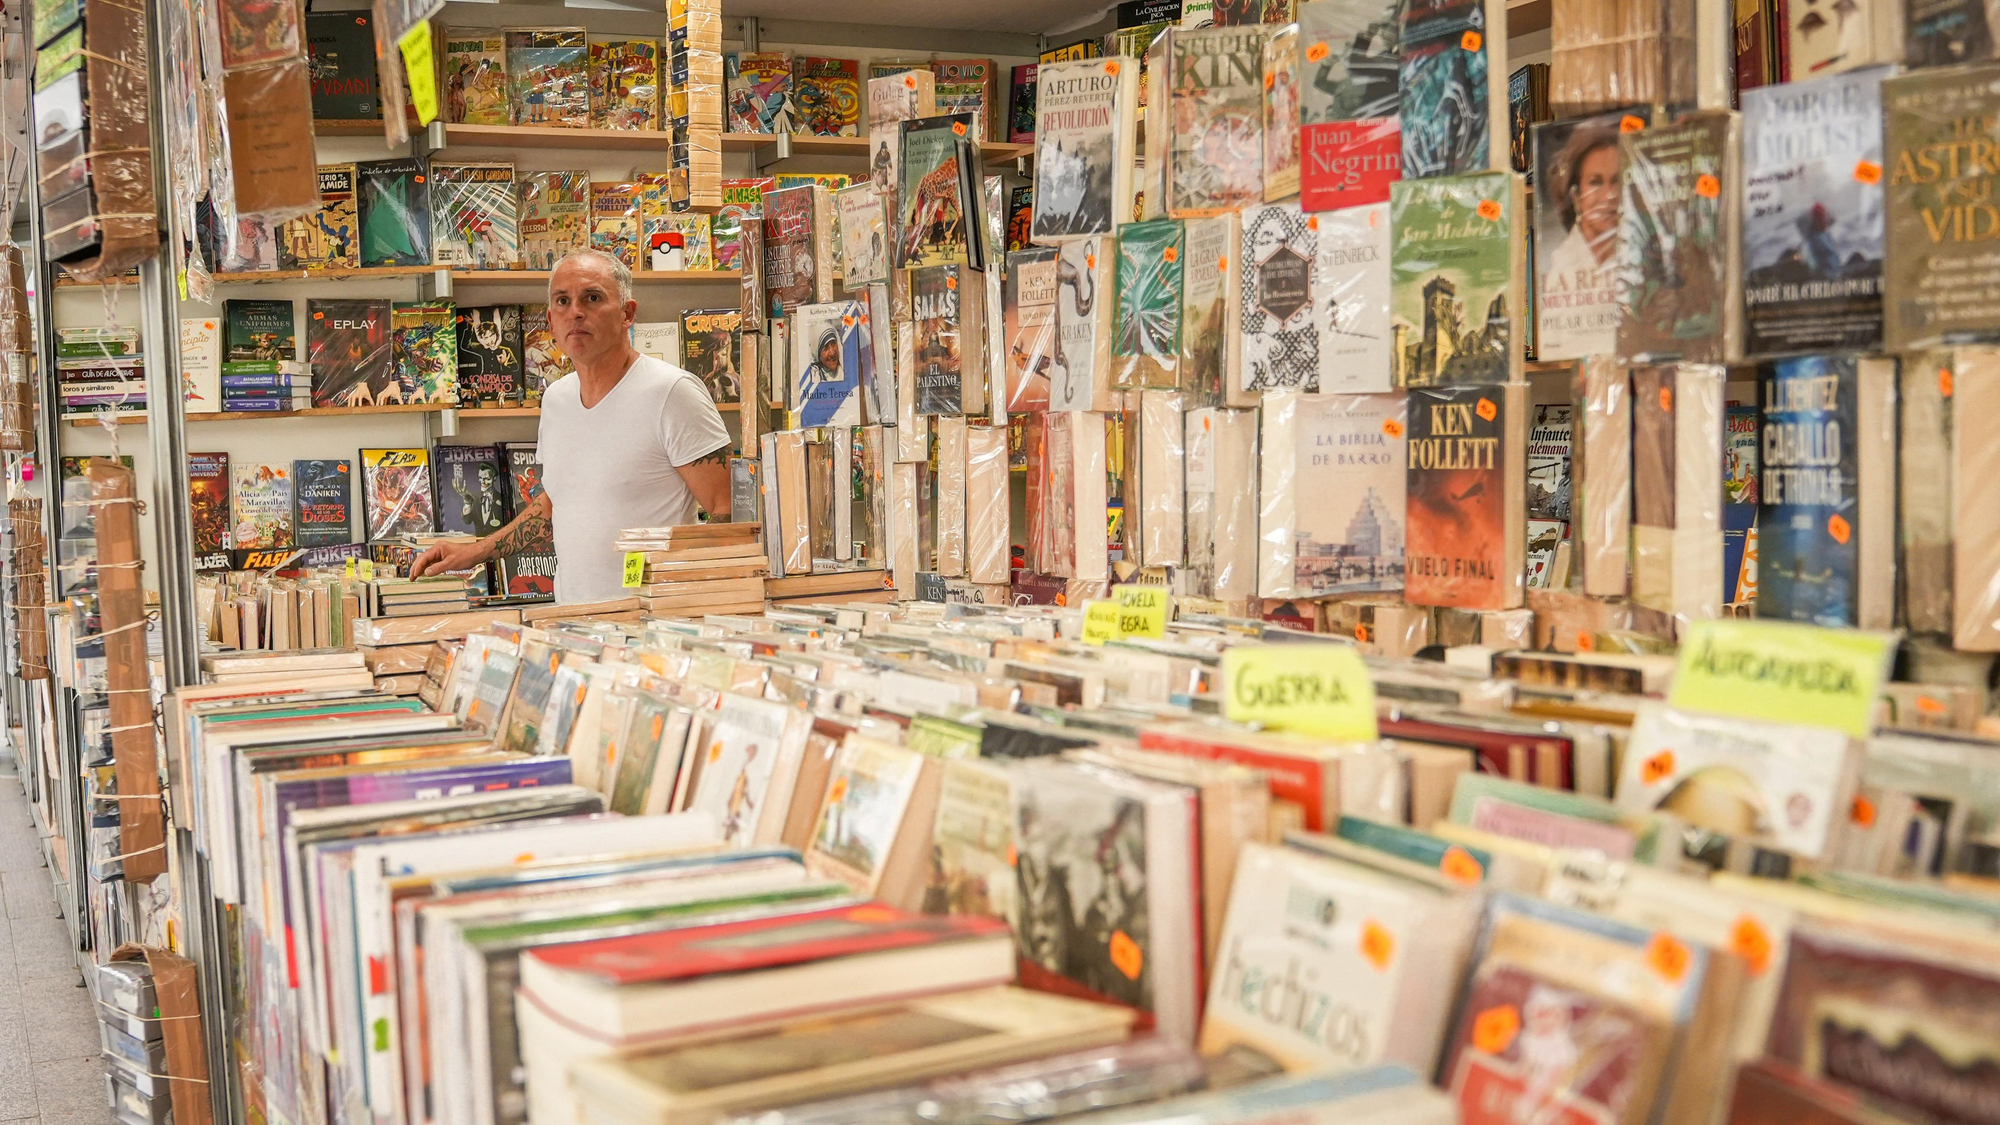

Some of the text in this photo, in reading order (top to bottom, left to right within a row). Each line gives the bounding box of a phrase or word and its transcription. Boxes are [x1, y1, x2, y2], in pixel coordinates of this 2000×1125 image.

[1173, 35, 1262, 57] STEPH
[826, 60, 843, 71] 4
[808, 69, 853, 79] FANTASTICOS
[873, 86, 904, 102] Gulag
[1045, 76, 1112, 96] ARTURO
[1044, 92, 1112, 107] PÉREZ-REVERTE
[1043, 105, 1110, 132] REVOLUCIÓN
[1310, 127, 1351, 150] Juan
[1309, 145, 1400, 185] Negrín
[1890, 137, 2000, 187] ASTR
[463, 171, 484, 181] FLASH
[485, 170, 511, 181] GORDON
[595, 197, 628, 205] JOHAN
[723, 186, 763, 204] LA MASA
[763, 189, 812, 212] STEPHEN
[764, 206, 813, 242] KING
[1321, 244, 1380, 267] STEINBECK
[1029, 277, 1046, 288] KEN
[1021, 287, 1055, 302] FOLLETT
[914, 289, 956, 321] SALAS
[240, 320, 291, 328] UNIFORMES
[324, 319, 377, 330] REPLAY
[685, 314, 742, 334] CREEP
[1061, 322, 1093, 342] KRAKEN
[82, 369, 96, 378] GUÍA
[929, 364, 940, 375] EL
[460, 374, 514, 385] LA SONRISA DEL
[916, 374, 957, 388] PALESTINO
[802, 386, 854, 401] Madre Teresa
[1430, 402, 1474, 436] KEN
[1315, 433, 1386, 447] LA BIBLIA
[1530, 425, 1573, 444] Infante
[1527, 442, 1568, 456] alemana
[1762, 418, 1841, 468] CABALLO
[445, 448, 495, 460] JOKER
[1311, 452, 1392, 466] DE BARRO
[1407, 437, 1499, 471] FOLLETT
[238, 490, 261, 498] Alicia
[1762, 466, 1783, 506] DE
[245, 498, 287, 506] Maravillas
[261, 506, 272, 514] del
[272, 505, 289, 515] espejo
[302, 510, 346, 524] DIOSES
[309, 546, 363, 563] JOKER
[1407, 556, 1495, 579] VUELO FINAL
[927, 586, 943, 600] KEN
[1119, 615, 1150, 633] EGRA
[1234, 660, 1350, 709] GUERRA
[1219, 932, 1371, 1062] hechizos
